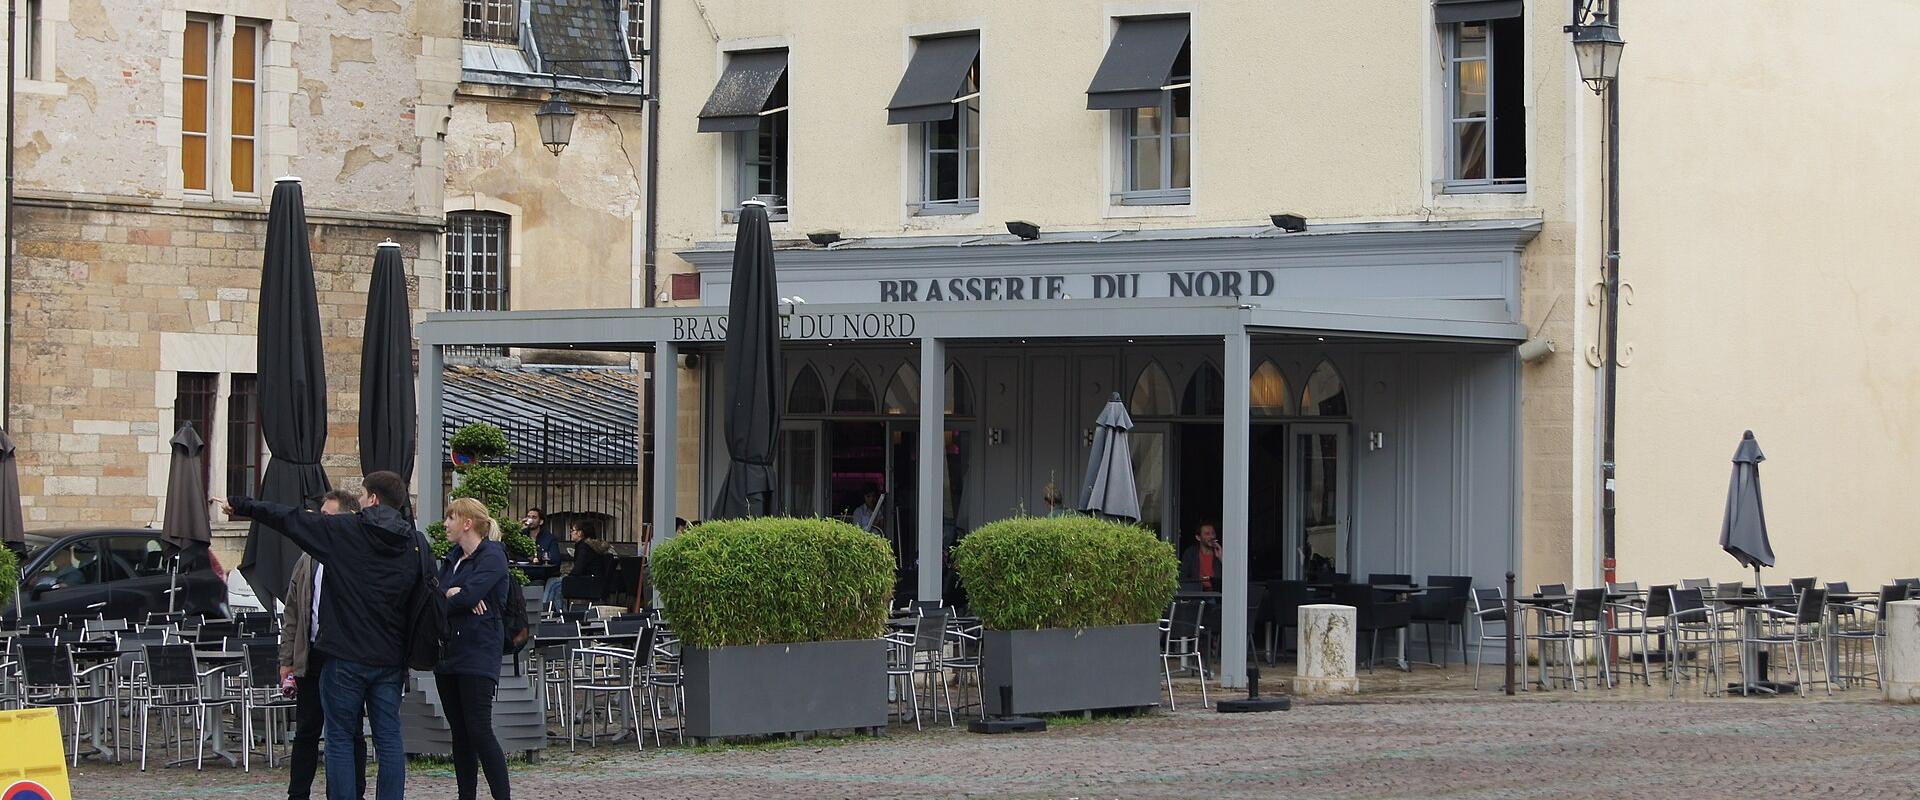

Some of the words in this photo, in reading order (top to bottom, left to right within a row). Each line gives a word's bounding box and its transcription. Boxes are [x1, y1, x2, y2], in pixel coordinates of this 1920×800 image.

[879, 276, 1065, 302] BRASSERIE
[1091, 273, 1140, 298] DU
[1167, 270, 1275, 297] NORD
[672, 315, 791, 340] BRASE
[800, 314, 835, 338] DU
[843, 313, 915, 338] NORD
